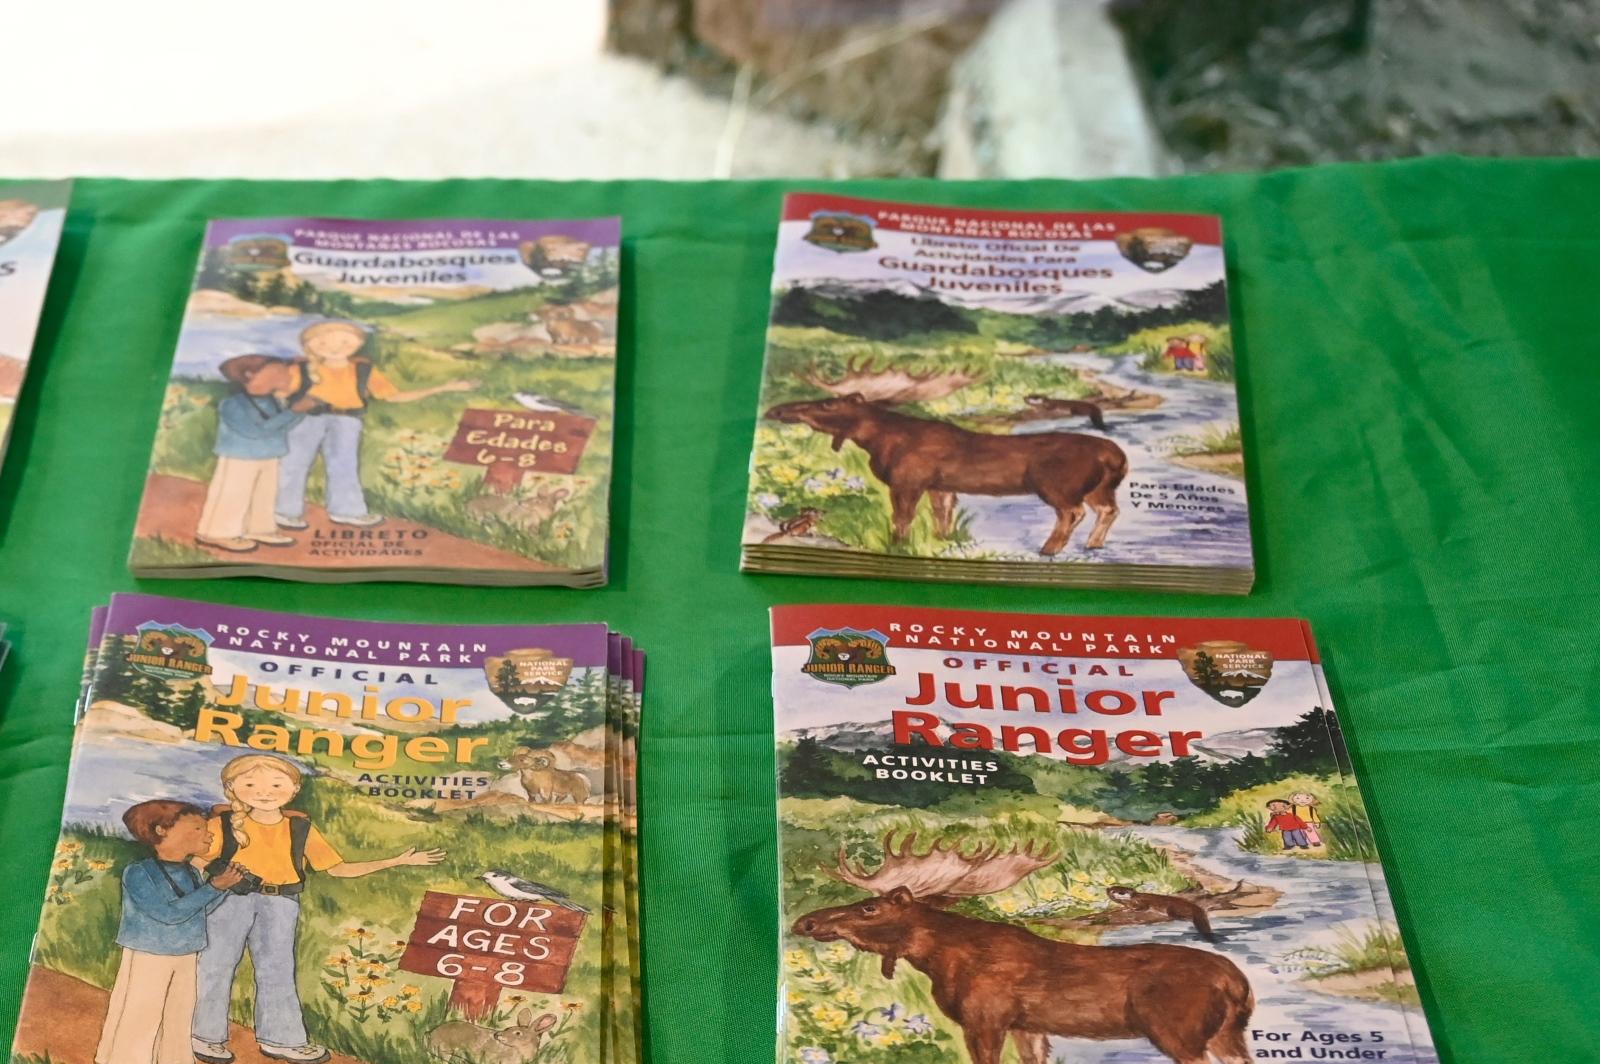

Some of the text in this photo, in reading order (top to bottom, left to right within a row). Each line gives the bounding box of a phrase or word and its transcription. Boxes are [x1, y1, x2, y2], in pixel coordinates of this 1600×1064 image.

[294, 252, 516, 268] Guardabosques
[913, 248, 1077, 264] Actividades Para
[337, 270, 468, 285] Juveniles
[878, 255, 1114, 281] Guardabosques
[927, 276, 1063, 295] Juveniles
[493, 412, 555, 432] Para
[466, 430, 568, 453] Edades
[1129, 481, 1236, 495] Para Edades
[1130, 491, 1220, 503] De 5 Años
[1147, 501, 1226, 513] Menores
[314, 529, 428, 540] LIBRETO
[308, 548, 424, 557] ACTIVIDADES
[216, 623, 487, 653] ROCKY MOUNTAIN
[889, 622, 1176, 644] ROCKY MOUNTAIN
[229, 636, 472, 664] NATIONAL PARK
[905, 634, 1163, 654] NATIONAL PARK
[127, 653, 165, 668] JUNIOR
[169, 657, 213, 675] RANGER
[259, 661, 439, 685] OFFICIAL
[803, 662, 897, 675] JUNIOR RANGER
[942, 656, 1134, 677] OFFICIAL
[214, 673, 473, 724] Junior
[904, 672, 1176, 716] Junior
[194, 708, 489, 770] Ranger
[891, 709, 1203, 766] Ranger
[862, 754, 999, 773] ACTIVITIES
[357, 772, 489, 787] ACTIVITIES
[875, 767, 988, 785] BOOKLET
[367, 786, 477, 800] BOOKLET
[448, 897, 553, 932] FOR
[426, 924, 552, 961] AGES
[436, 953, 527, 986] 6-8
[1251, 1029, 1385, 1045] For Ages 5
[1255, 1046, 1388, 1060] and Under
